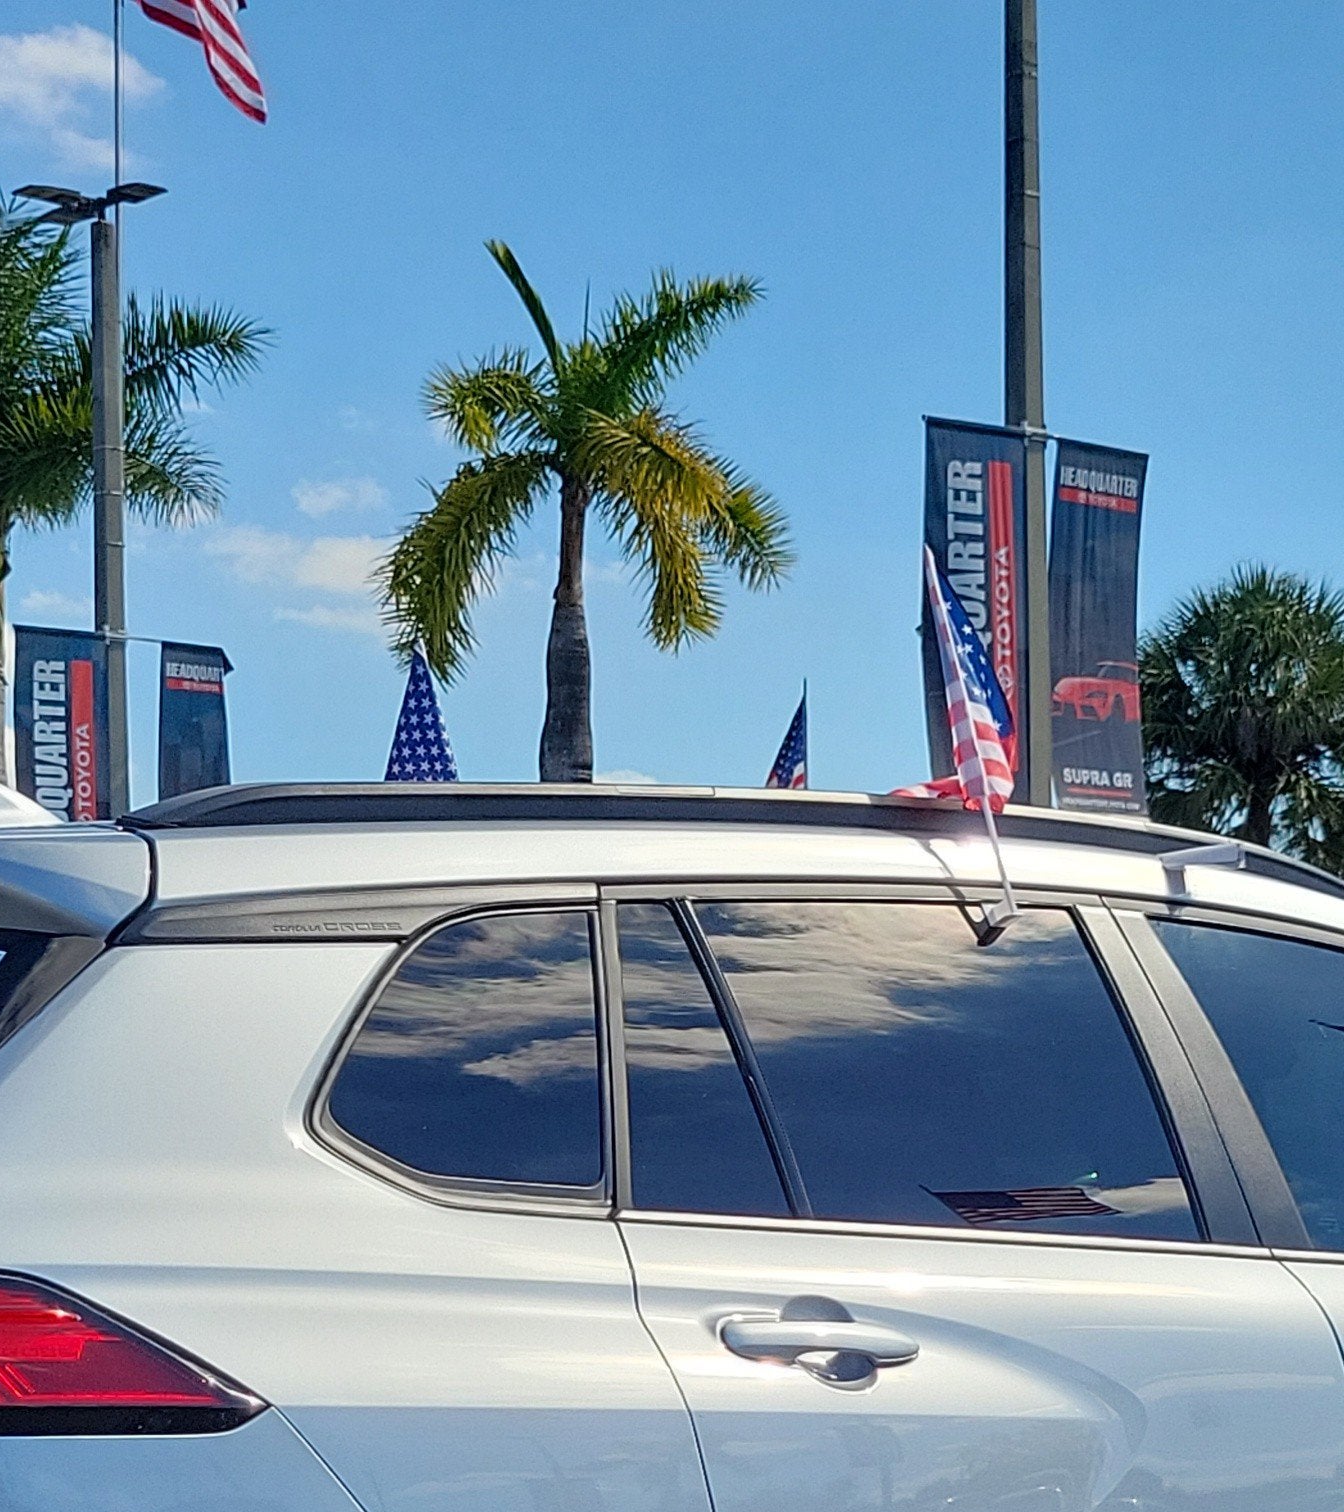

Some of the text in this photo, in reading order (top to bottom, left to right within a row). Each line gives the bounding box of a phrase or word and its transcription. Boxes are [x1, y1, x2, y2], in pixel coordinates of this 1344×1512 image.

[1060, 465, 1138, 498] HEADQUARTER
[947, 460, 992, 651] UARTER
[995, 546, 1012, 662] TOYOTA
[76, 723, 92, 811] TOYOTA
[1063, 767, 1133, 788] SUPRA GR
[322, 921, 403, 931] CROSS
